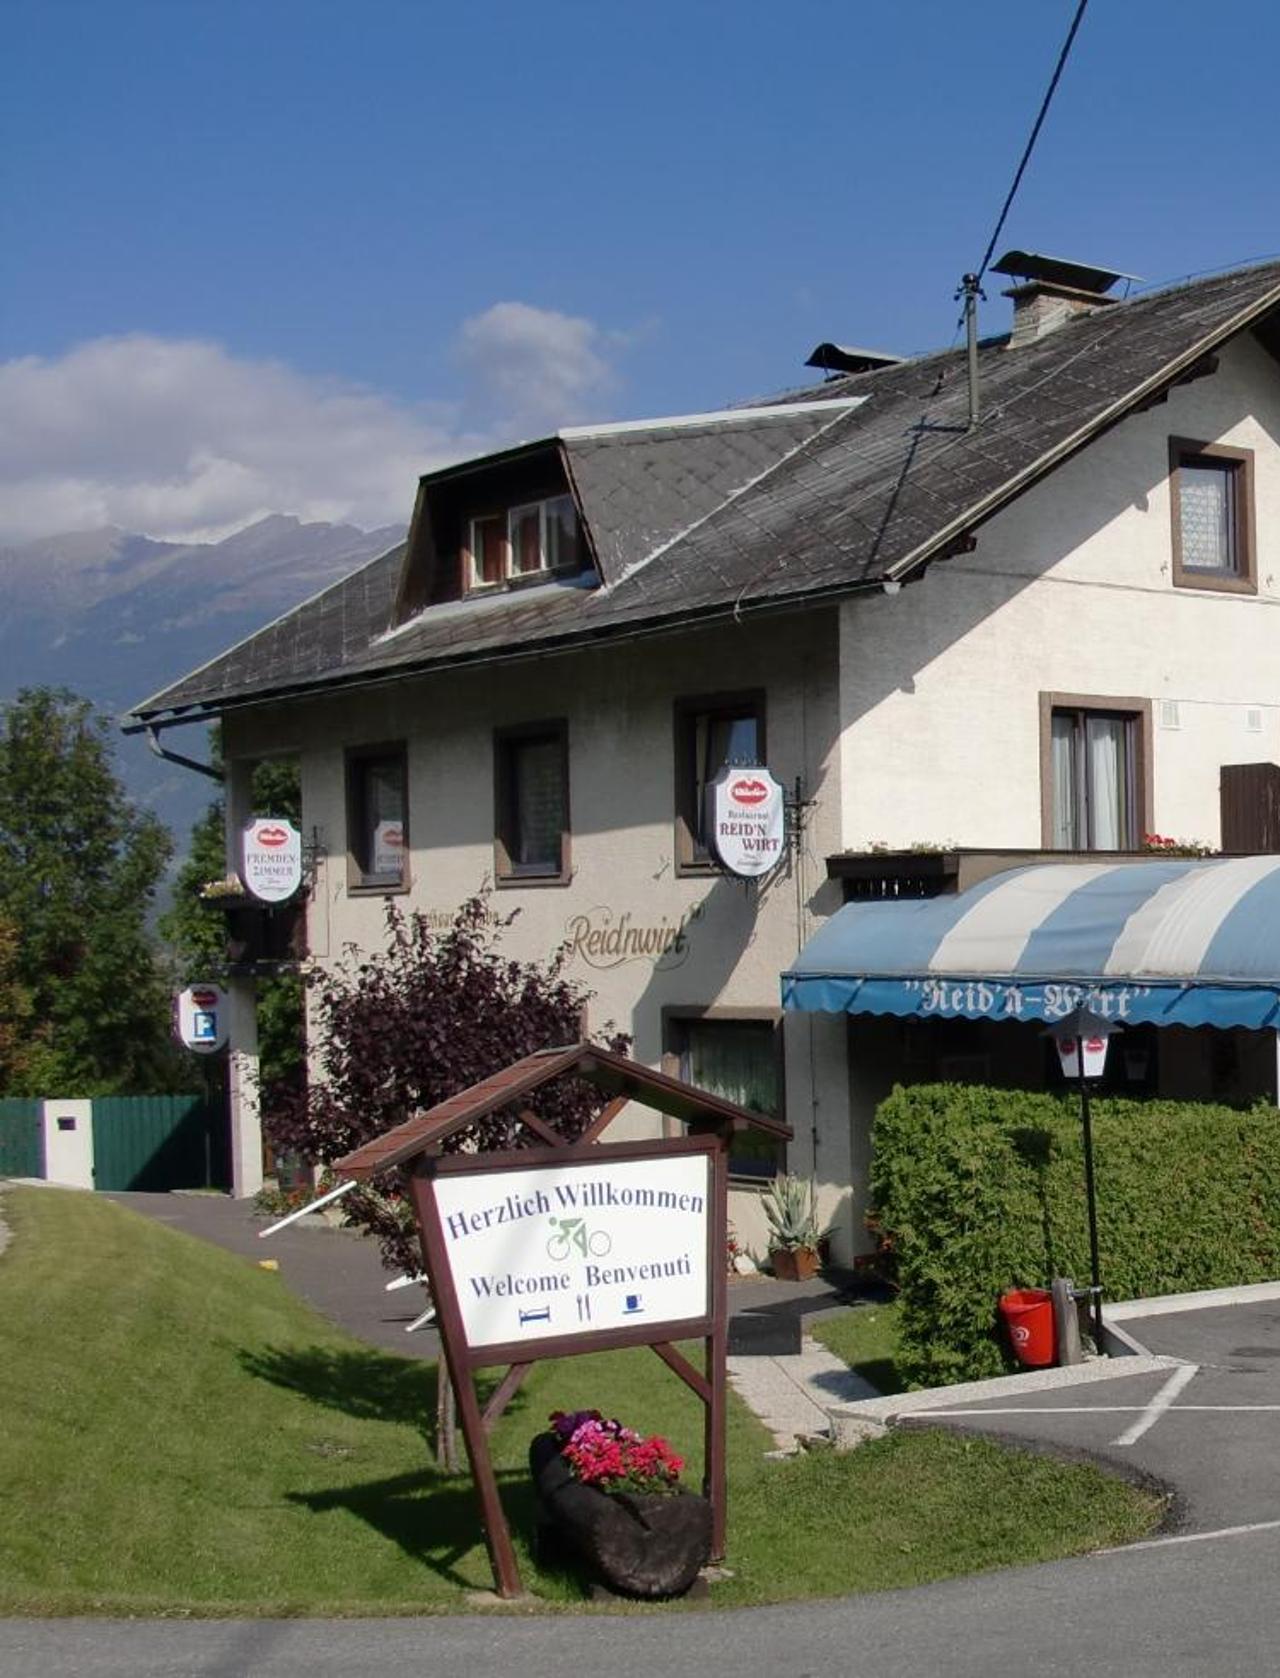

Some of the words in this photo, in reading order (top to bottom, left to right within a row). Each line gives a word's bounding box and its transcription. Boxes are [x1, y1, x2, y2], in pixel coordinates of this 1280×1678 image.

[719, 822, 767, 836] REID'N
[742, 837, 781, 852] WIRT
[252, 866, 294, 877] ZIMMER
[447, 1190, 551, 1241] Herzlich
[554, 1182, 705, 1215] Willkommen
[470, 1273, 571, 1299] Welcome
[585, 1254, 692, 1288] Benvenuti
